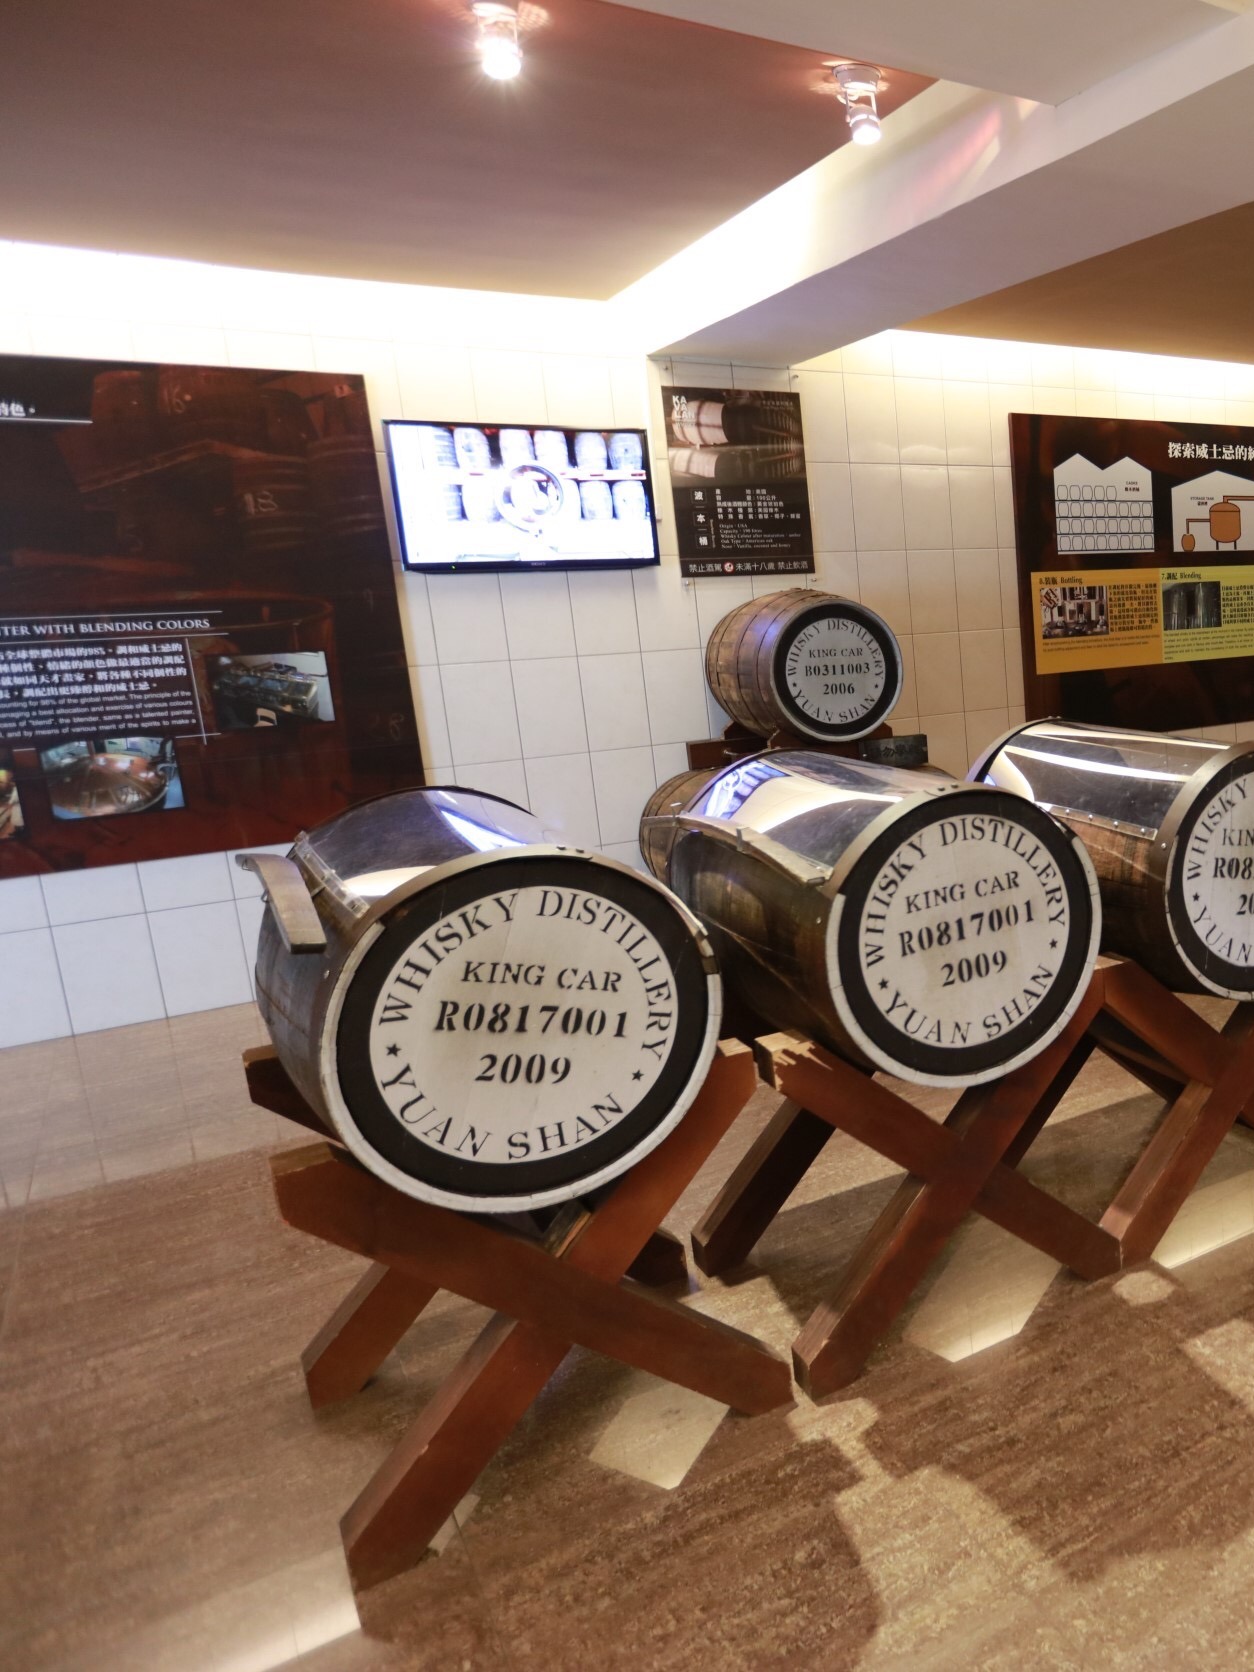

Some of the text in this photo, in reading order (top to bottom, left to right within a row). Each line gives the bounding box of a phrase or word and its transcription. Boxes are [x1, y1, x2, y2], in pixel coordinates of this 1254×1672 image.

[689, 560, 808, 573] 禁止酒駕 未滿十八歲 禁止飲酒
[0, 619, 210, 637] TER WITH BLENDING COLORS
[787, 619, 884, 680] WHISKY DISTILLERY
[809, 648, 863, 658] KING CAR
[793, 689, 876, 722] YUAN SHAN
[823, 682, 855, 695] 2006
[1187, 778, 1249, 881] WHISKY
[865, 816, 1066, 970] WHISKY DISTILLERY
[905, 870, 1020, 915] KING CAR
[898, 899, 1035, 958] R0817001
[1193, 905, 1252, 963] YUAN
[379, 889, 673, 1061] WHISKY DISTILLERY
[460, 960, 623, 994] KING CAR
[941, 950, 1008, 988] 2009
[434, 1000, 630, 1038] R0817001
[883, 964, 1054, 1045] YUAN SHAN
[475, 1053, 572, 1085] 2009
[380, 1063, 625, 1161] YUAN SHAN
